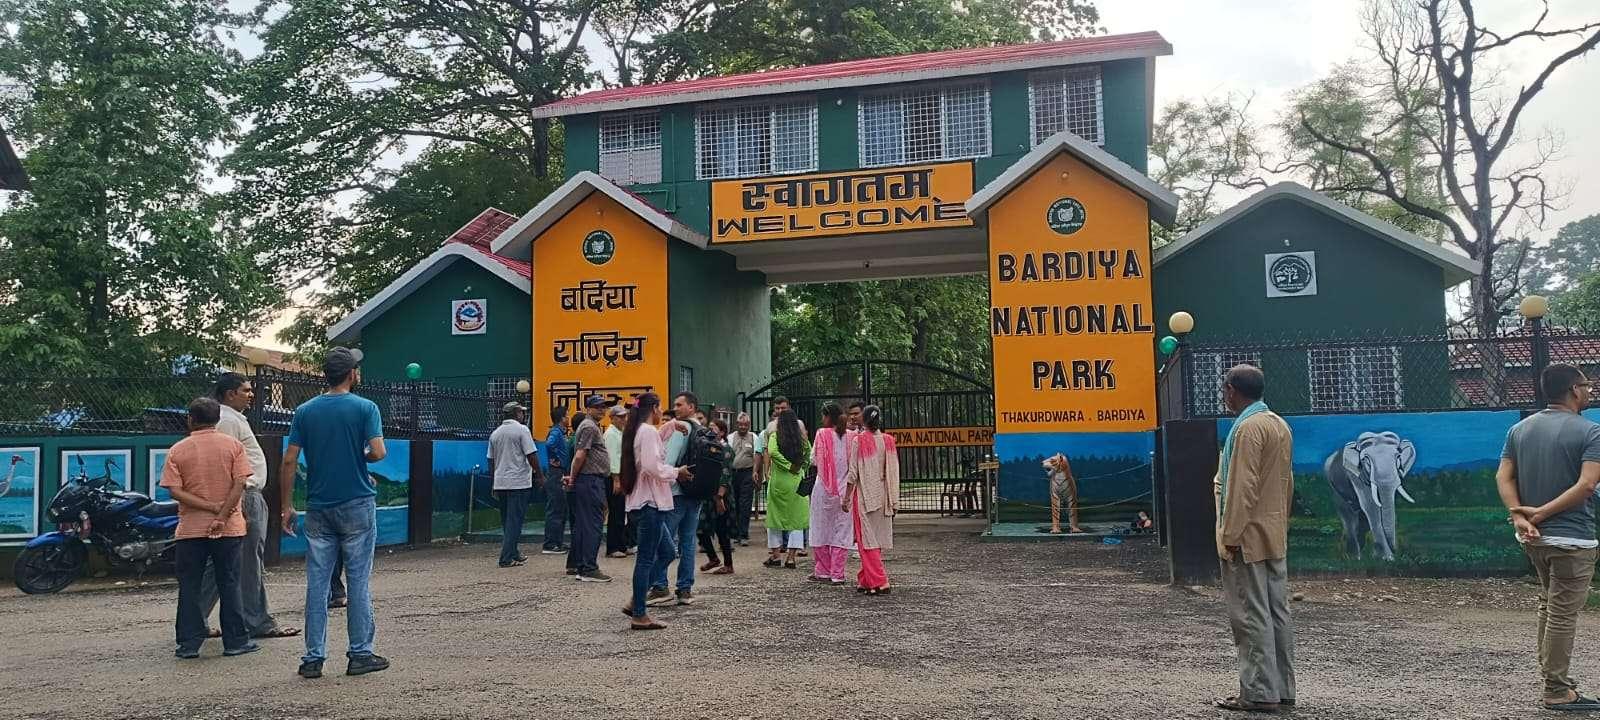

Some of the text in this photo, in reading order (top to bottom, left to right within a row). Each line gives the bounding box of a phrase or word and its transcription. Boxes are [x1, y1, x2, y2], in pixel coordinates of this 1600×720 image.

[716, 201, 968, 236] WELCOME
[998, 249, 1143, 282] BARDIYA
[560, 280, 638, 312] बर्दिया
[992, 304, 1154, 336] NATIONAL
[1032, 359, 1115, 390] PARK
[1000, 410, 1146, 424] THAKURDWARA BARDIYA
[915, 430, 966, 444] NATIONAL
